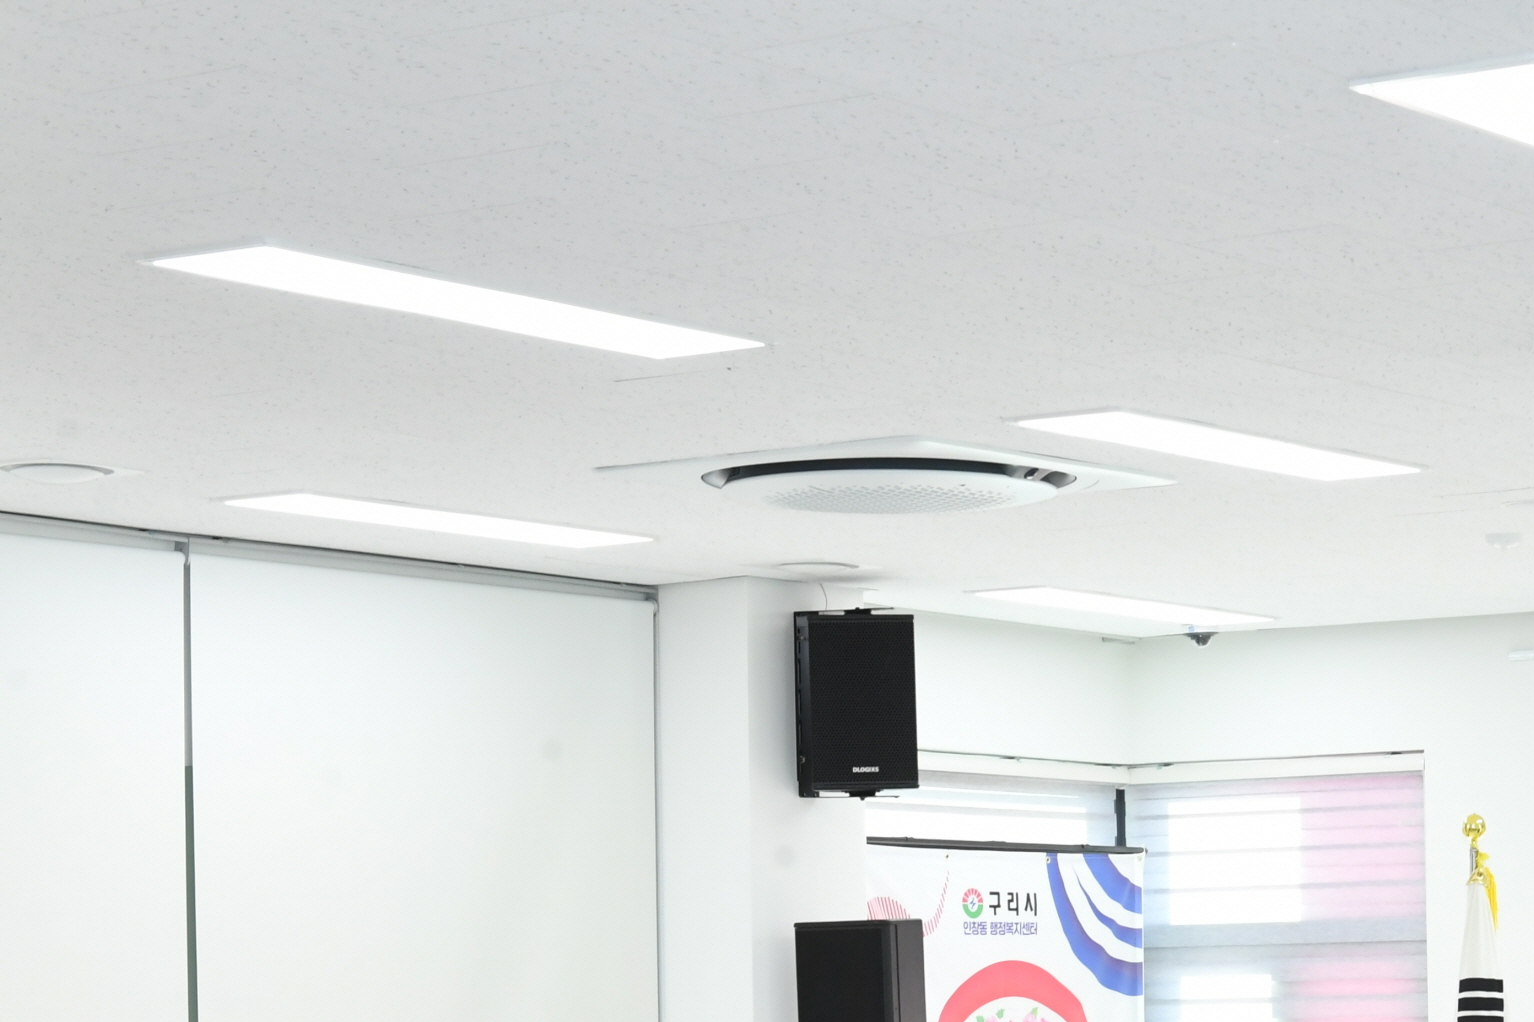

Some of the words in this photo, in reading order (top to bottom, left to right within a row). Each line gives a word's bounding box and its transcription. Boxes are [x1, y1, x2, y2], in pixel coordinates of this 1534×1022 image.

[988, 891, 1038, 917] 구리시
[963, 921, 988, 936] 인창동
[989, 921, 1038, 936] 행정복지센터
